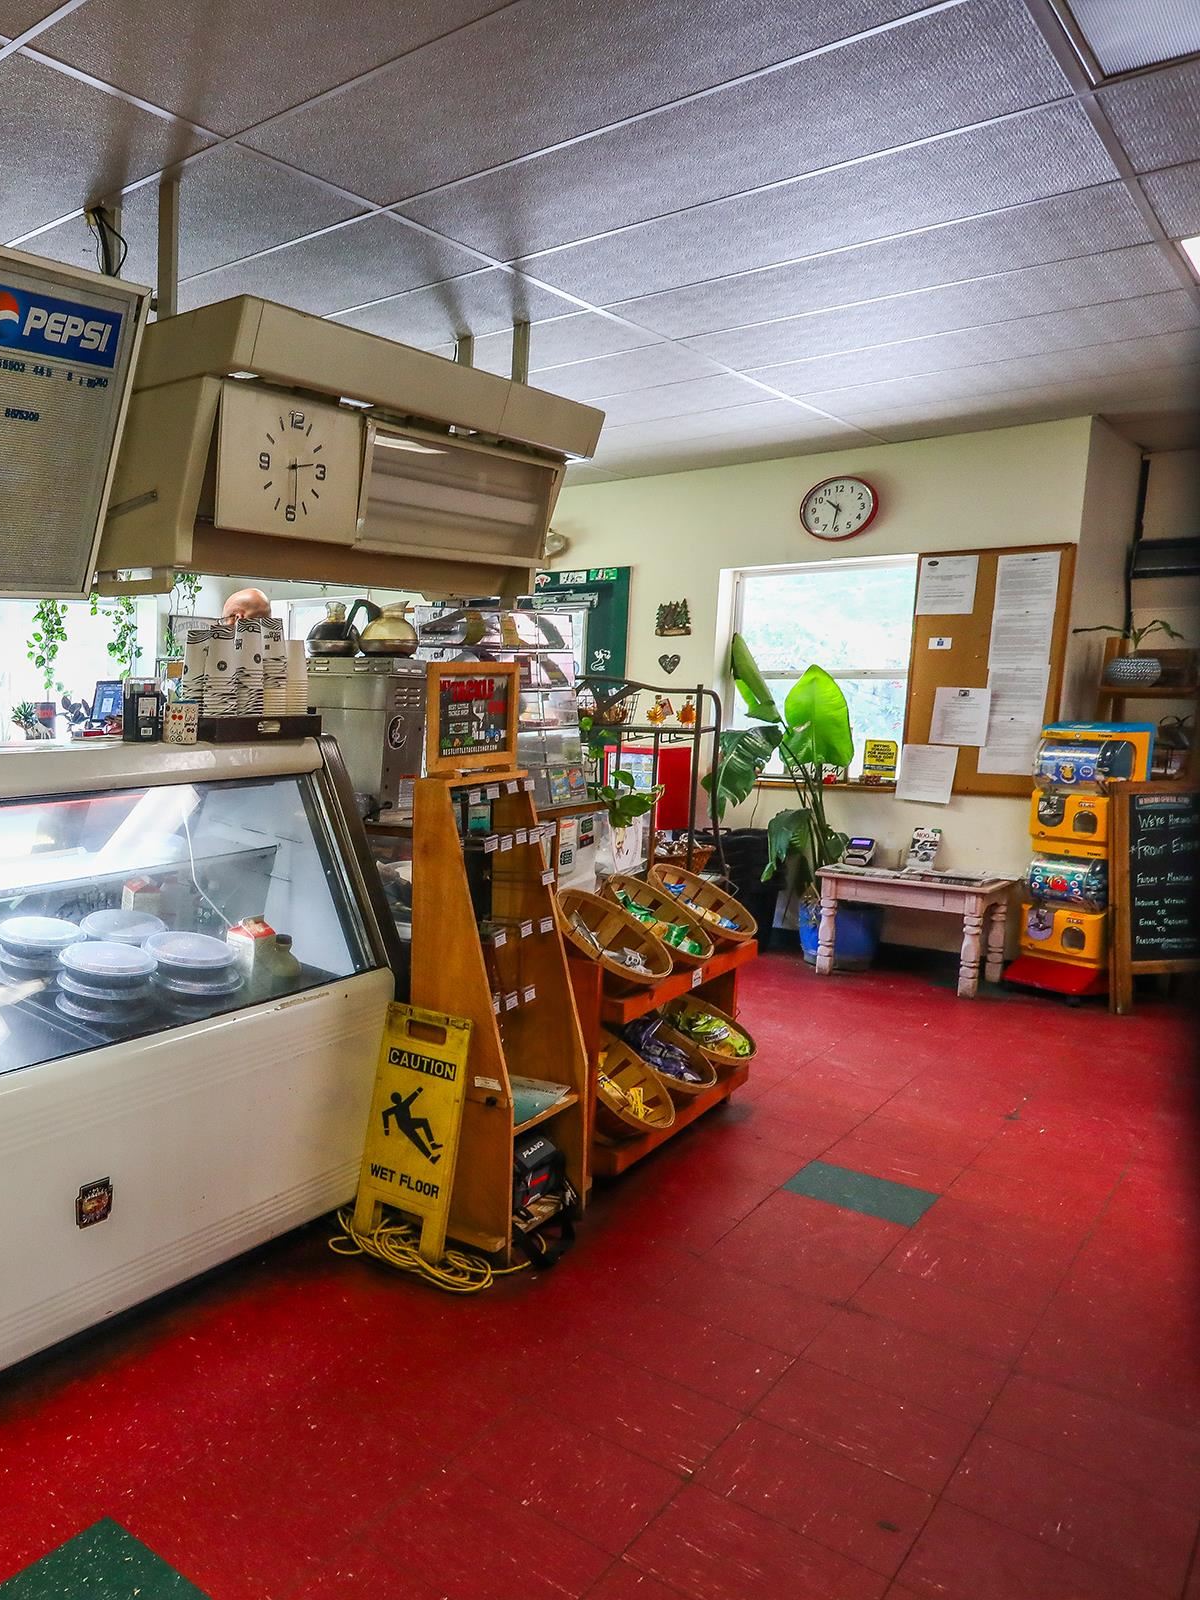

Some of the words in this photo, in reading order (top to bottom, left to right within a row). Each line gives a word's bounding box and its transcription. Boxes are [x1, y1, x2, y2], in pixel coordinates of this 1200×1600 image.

[22, 306, 112, 352] PEPSI
[289, 410, 305, 430] 12
[259, 452, 270, 470] 9
[315, 464, 326, 481] 3
[824, 488, 831, 496] 11
[835, 485, 845, 493] 12
[285, 504, 296, 522] 6
[846, 521, 851, 529] 5
[389, 1049, 456, 1080] CAUTION
[522, 1140, 544, 1158] PLANO
[370, 1163, 396, 1182] WET
[399, 1173, 440, 1199] FLOOR
